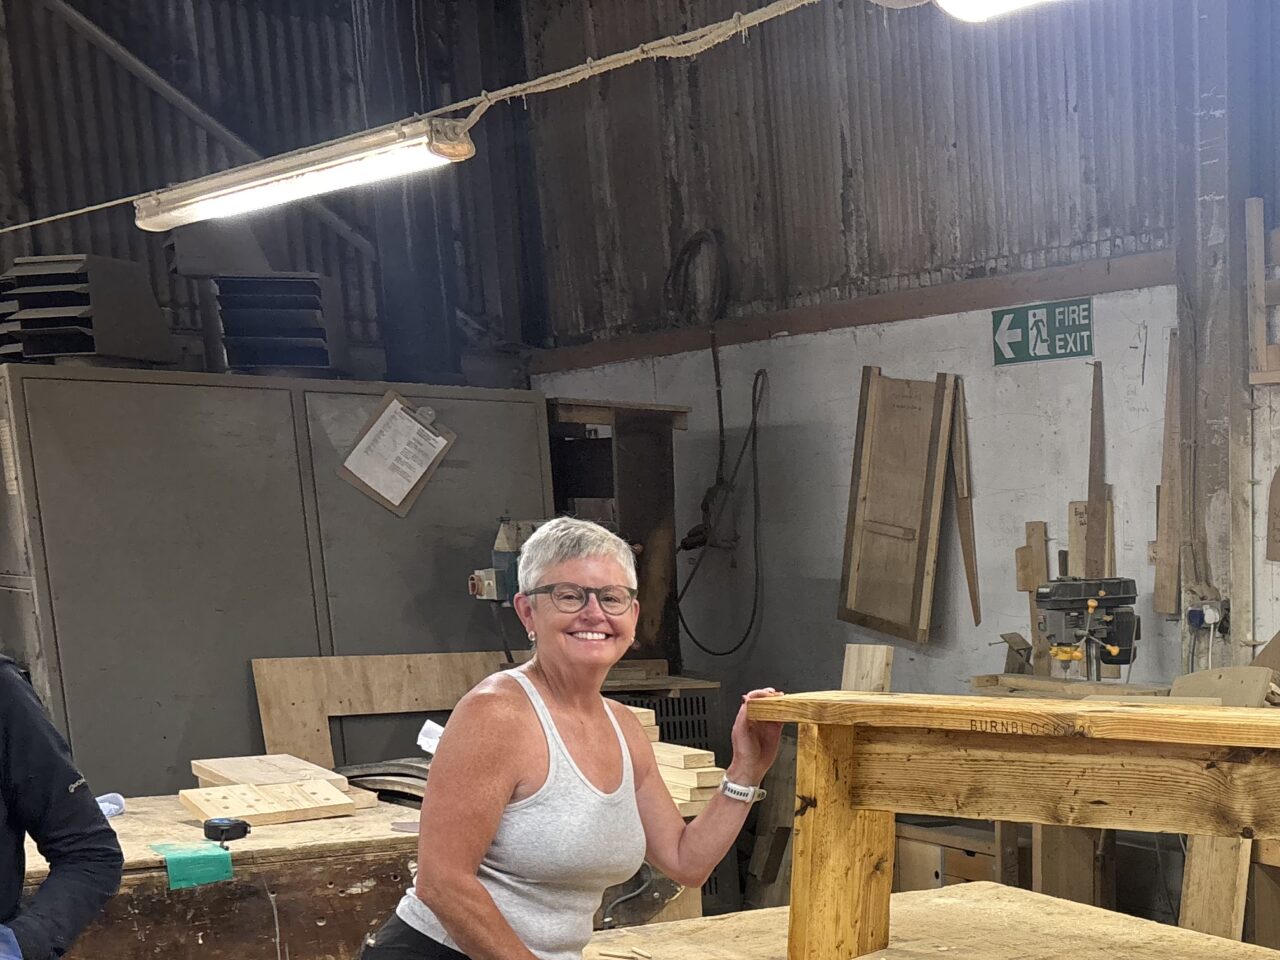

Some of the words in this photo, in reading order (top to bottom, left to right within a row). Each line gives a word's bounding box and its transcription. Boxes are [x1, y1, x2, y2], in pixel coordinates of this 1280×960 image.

[1055, 303, 1090, 328] FIRE
[1055, 330, 1090, 354] EXIT
[970, 719, 1061, 737] BURNBLOCK
